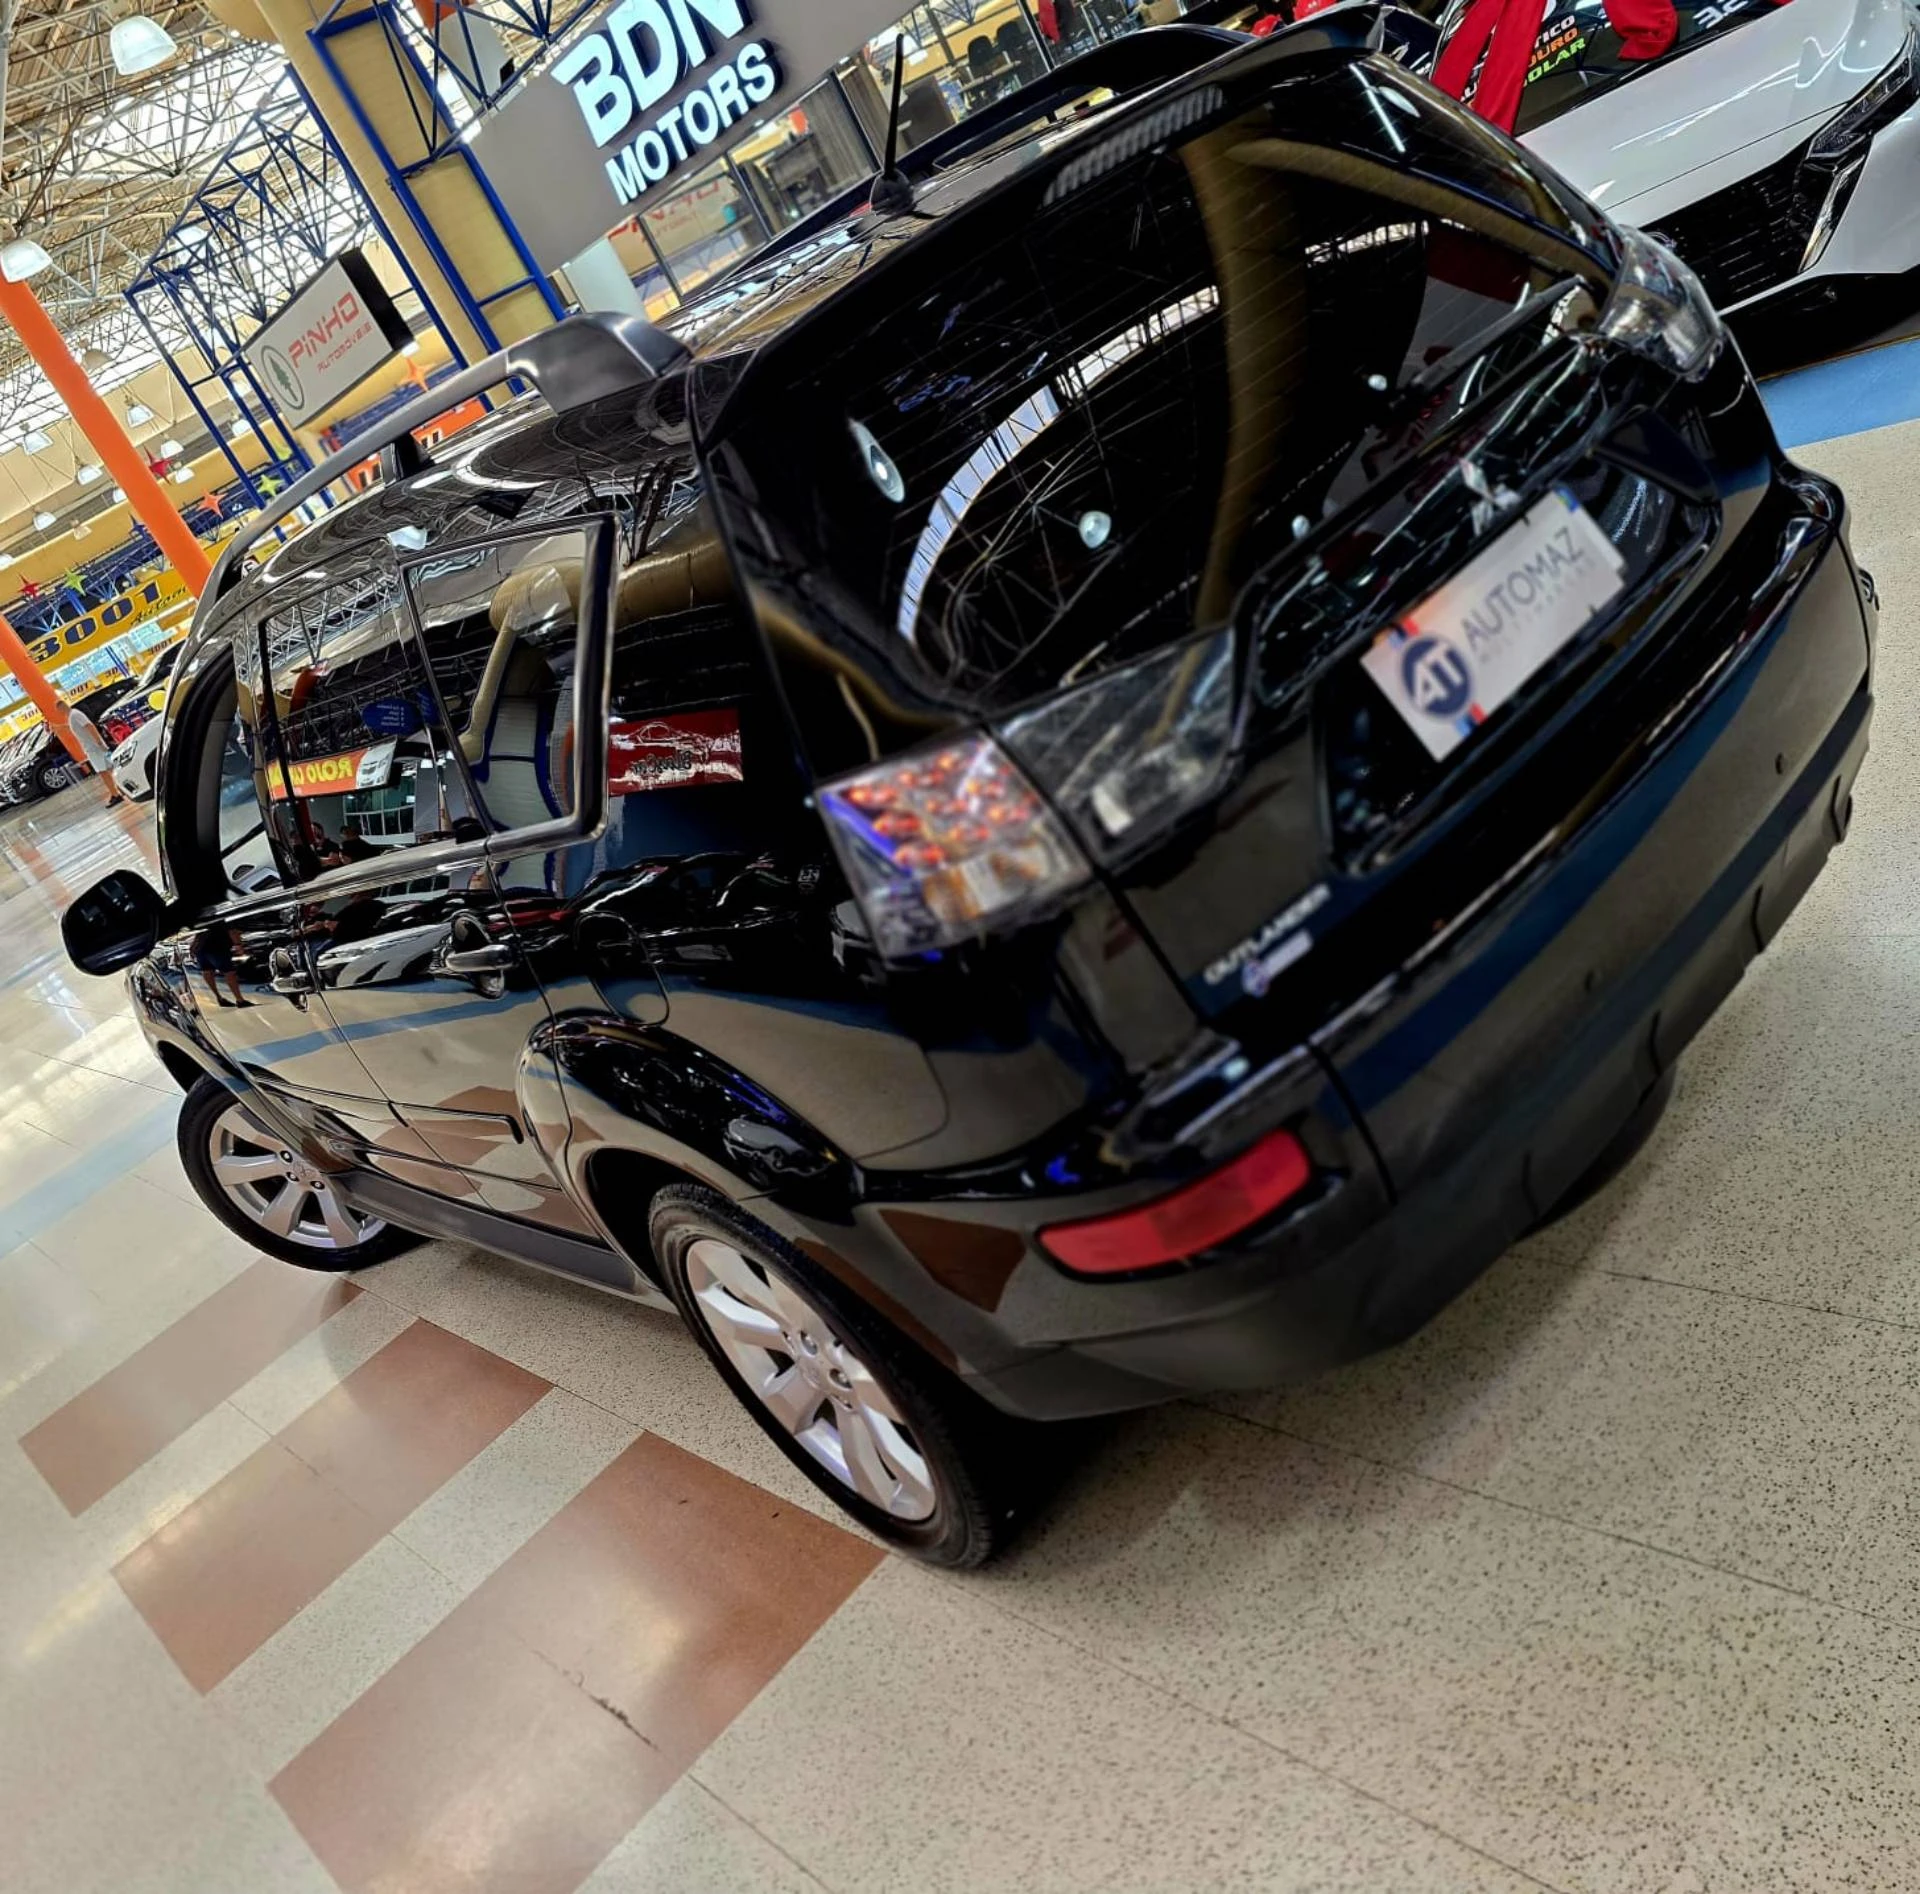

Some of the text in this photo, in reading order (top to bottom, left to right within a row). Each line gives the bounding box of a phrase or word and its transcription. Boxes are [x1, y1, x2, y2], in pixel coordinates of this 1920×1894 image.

[551, 0, 745, 148] BDN
[605, 43, 775, 205] MOTORS
[1524, 38, 1586, 87] OLAR
[29, 580, 161, 665] 3001
[1461, 525, 1585, 650] AUTOMAZ
